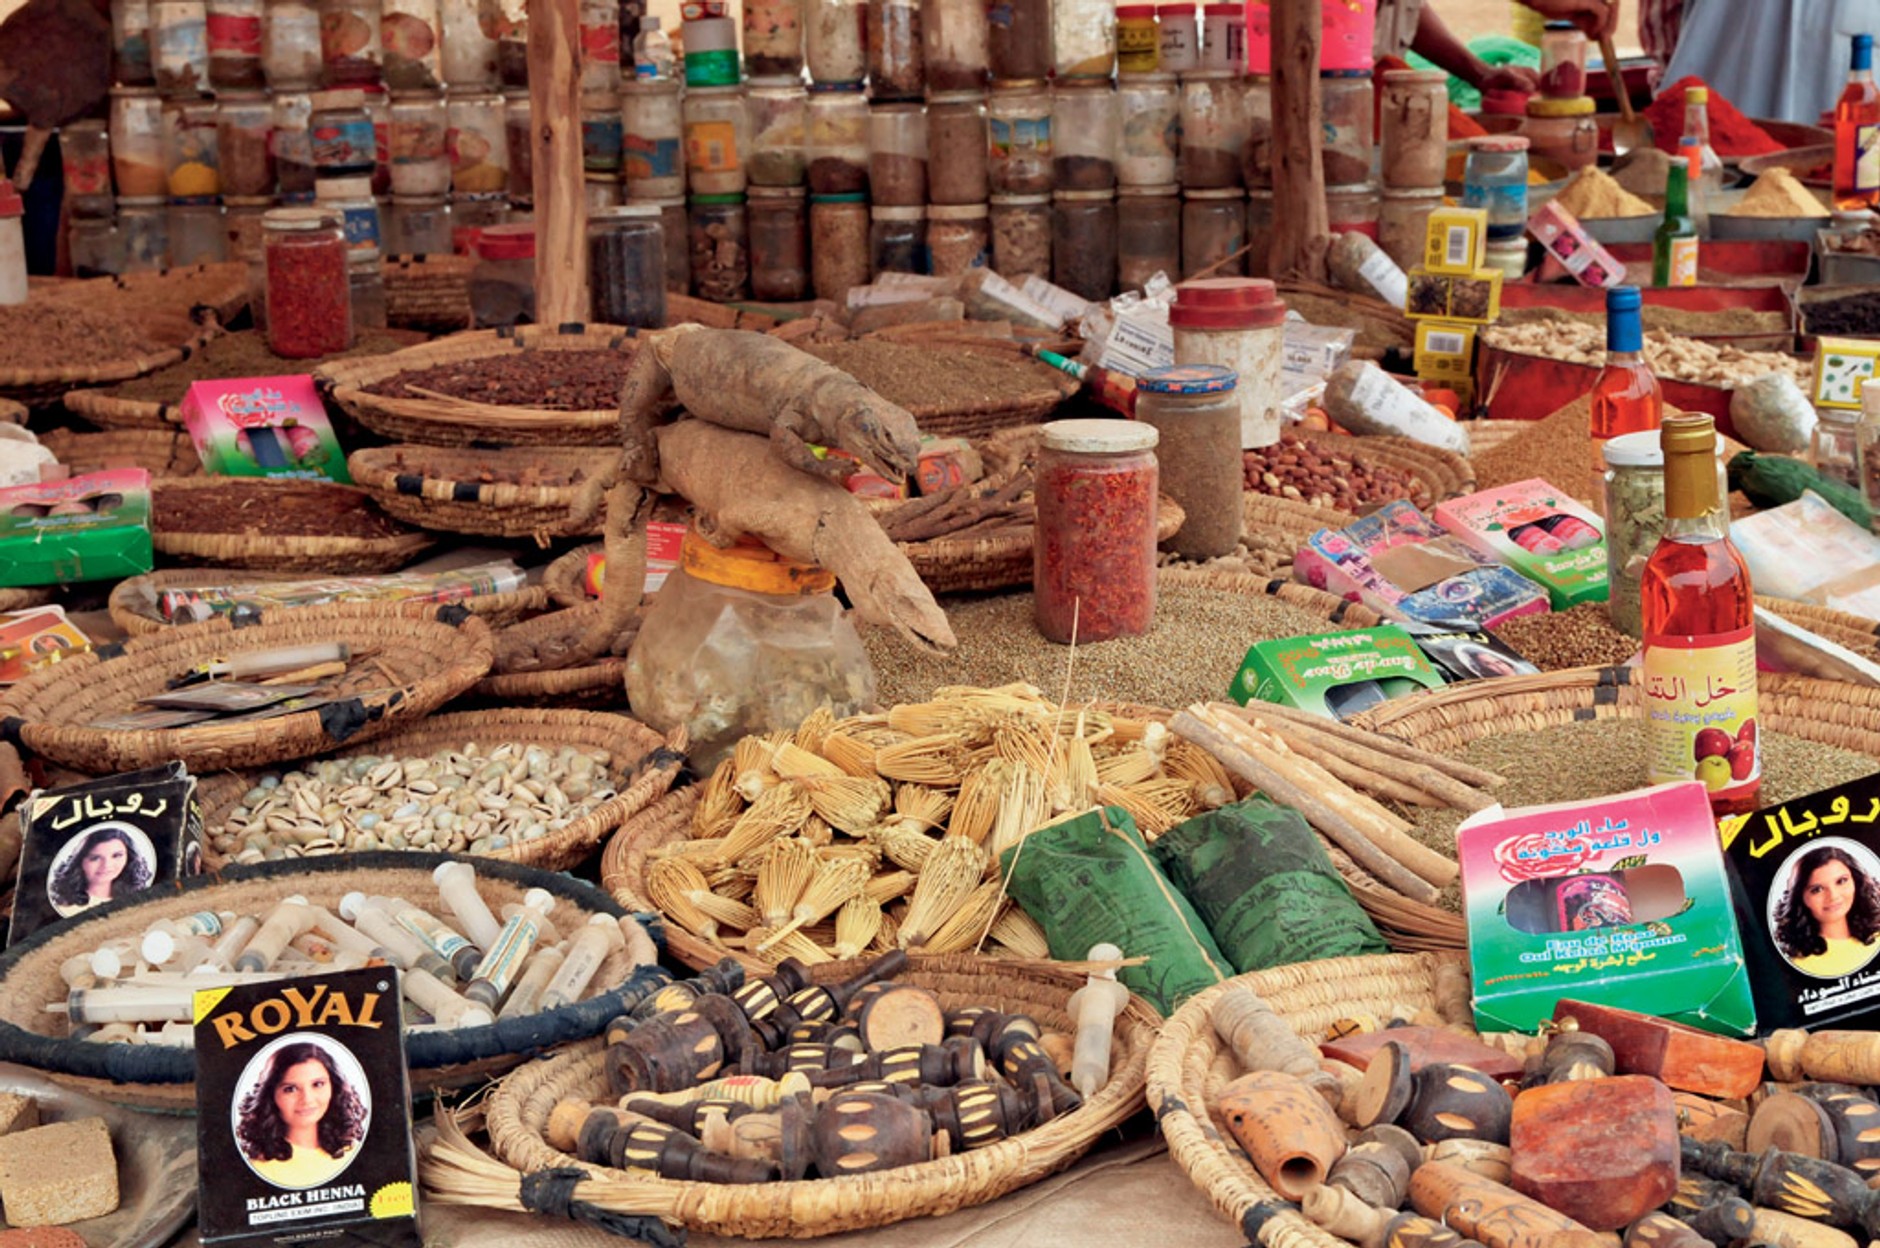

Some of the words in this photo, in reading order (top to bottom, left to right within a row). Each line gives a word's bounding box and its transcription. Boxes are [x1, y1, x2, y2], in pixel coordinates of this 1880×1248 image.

[1694, 673, 1737, 708] خل
[51, 792, 167, 831] رويال
[1596, 817, 1628, 832] ماء
[1544, 820, 1590, 840] الورد
[1749, 795, 1880, 859] رويال
[1546, 938, 1580, 951] Eau
[1584, 934, 1608, 948] de
[1610, 929, 1657, 945] Rose
[1798, 976, 1850, 1004] السوداء
[211, 984, 383, 1050] ROYAL
[246, 1193, 303, 1211] BLACK
[306, 1183, 366, 1204] HENNA
